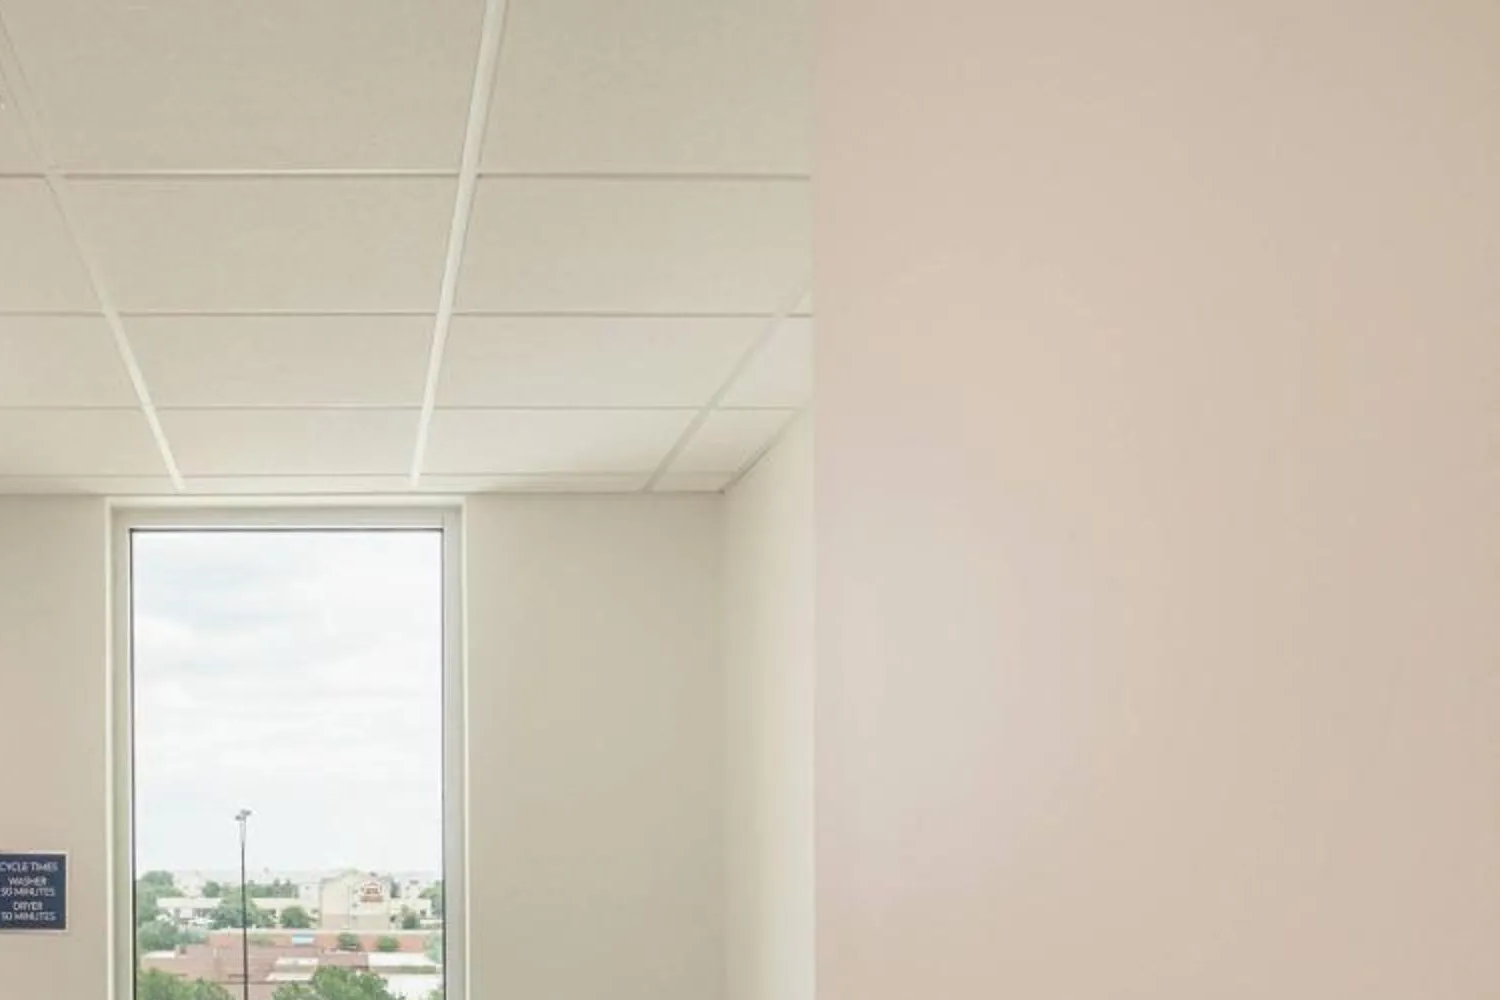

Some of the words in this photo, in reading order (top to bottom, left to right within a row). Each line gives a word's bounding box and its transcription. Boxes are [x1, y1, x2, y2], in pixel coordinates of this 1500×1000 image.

[31, 861, 59, 872] TIMES
[8, 875, 47, 886] WASHER
[14, 887, 56, 897] MINUTES
[12, 901, 43, 911] DRYER
[14, 911, 57, 921] MINUTES
